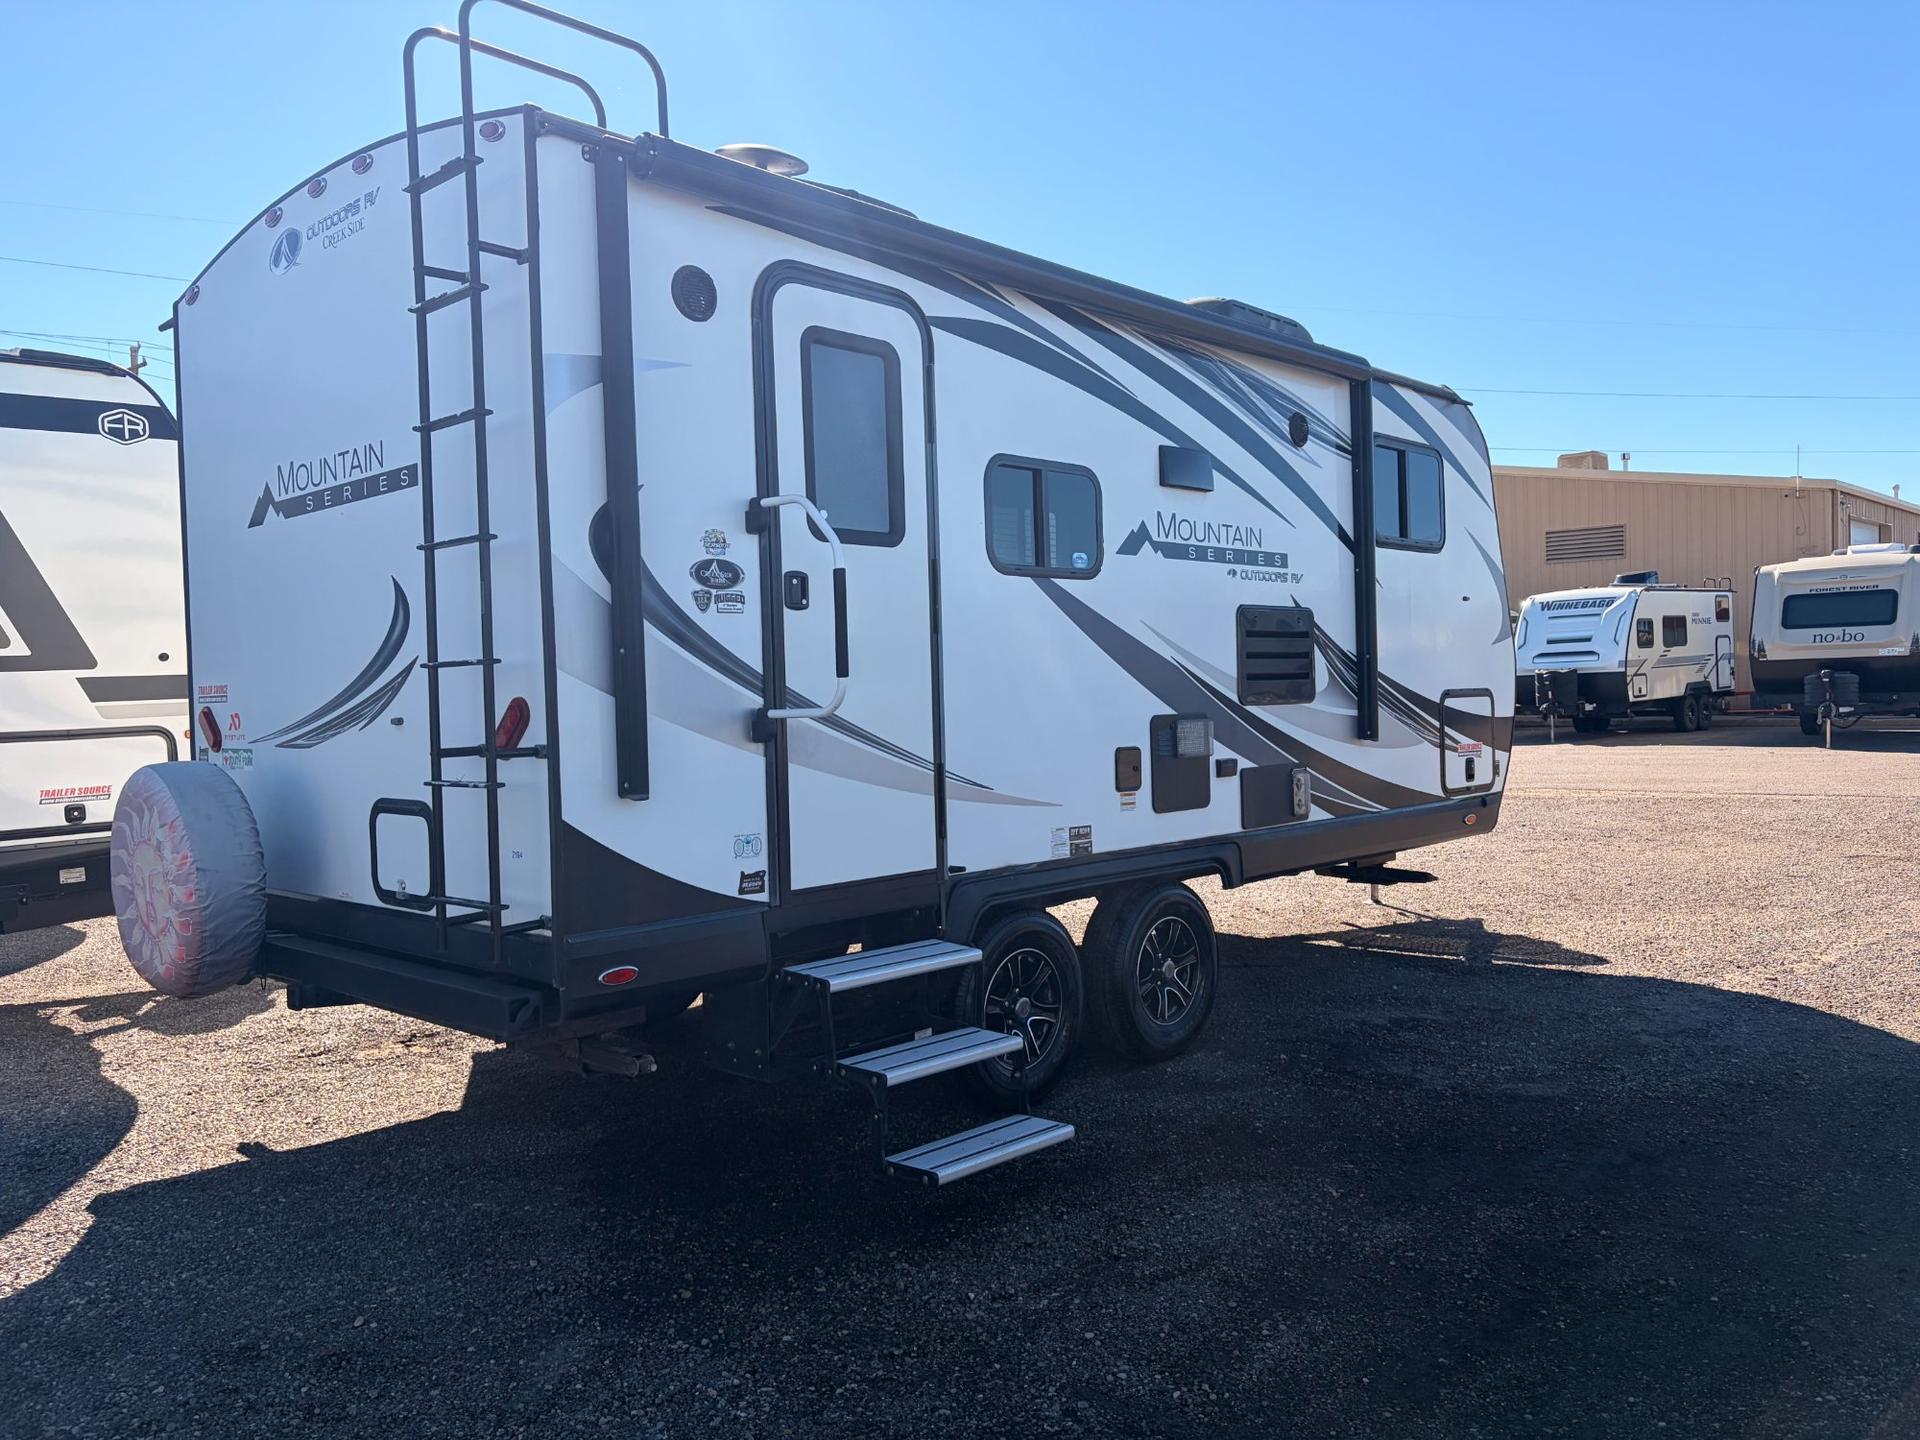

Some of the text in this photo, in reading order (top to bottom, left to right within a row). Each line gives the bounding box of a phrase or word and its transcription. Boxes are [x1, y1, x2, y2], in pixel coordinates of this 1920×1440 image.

[306, 197, 361, 240] OUTDOORS
[322, 217, 365, 249] CREEK SIDE
[277, 440, 384, 497] MOUNTAIN
[306, 470, 409, 510] SERIES
[1157, 511, 1262, 548] MOUNTAIN
[1189, 547, 1281, 566] SERIES
[1240, 569, 1288, 583] OUTDOORS
[1540, 600, 1615, 611] WINNEBAGO
[40, 785, 112, 798] TRAILER SOURCE
